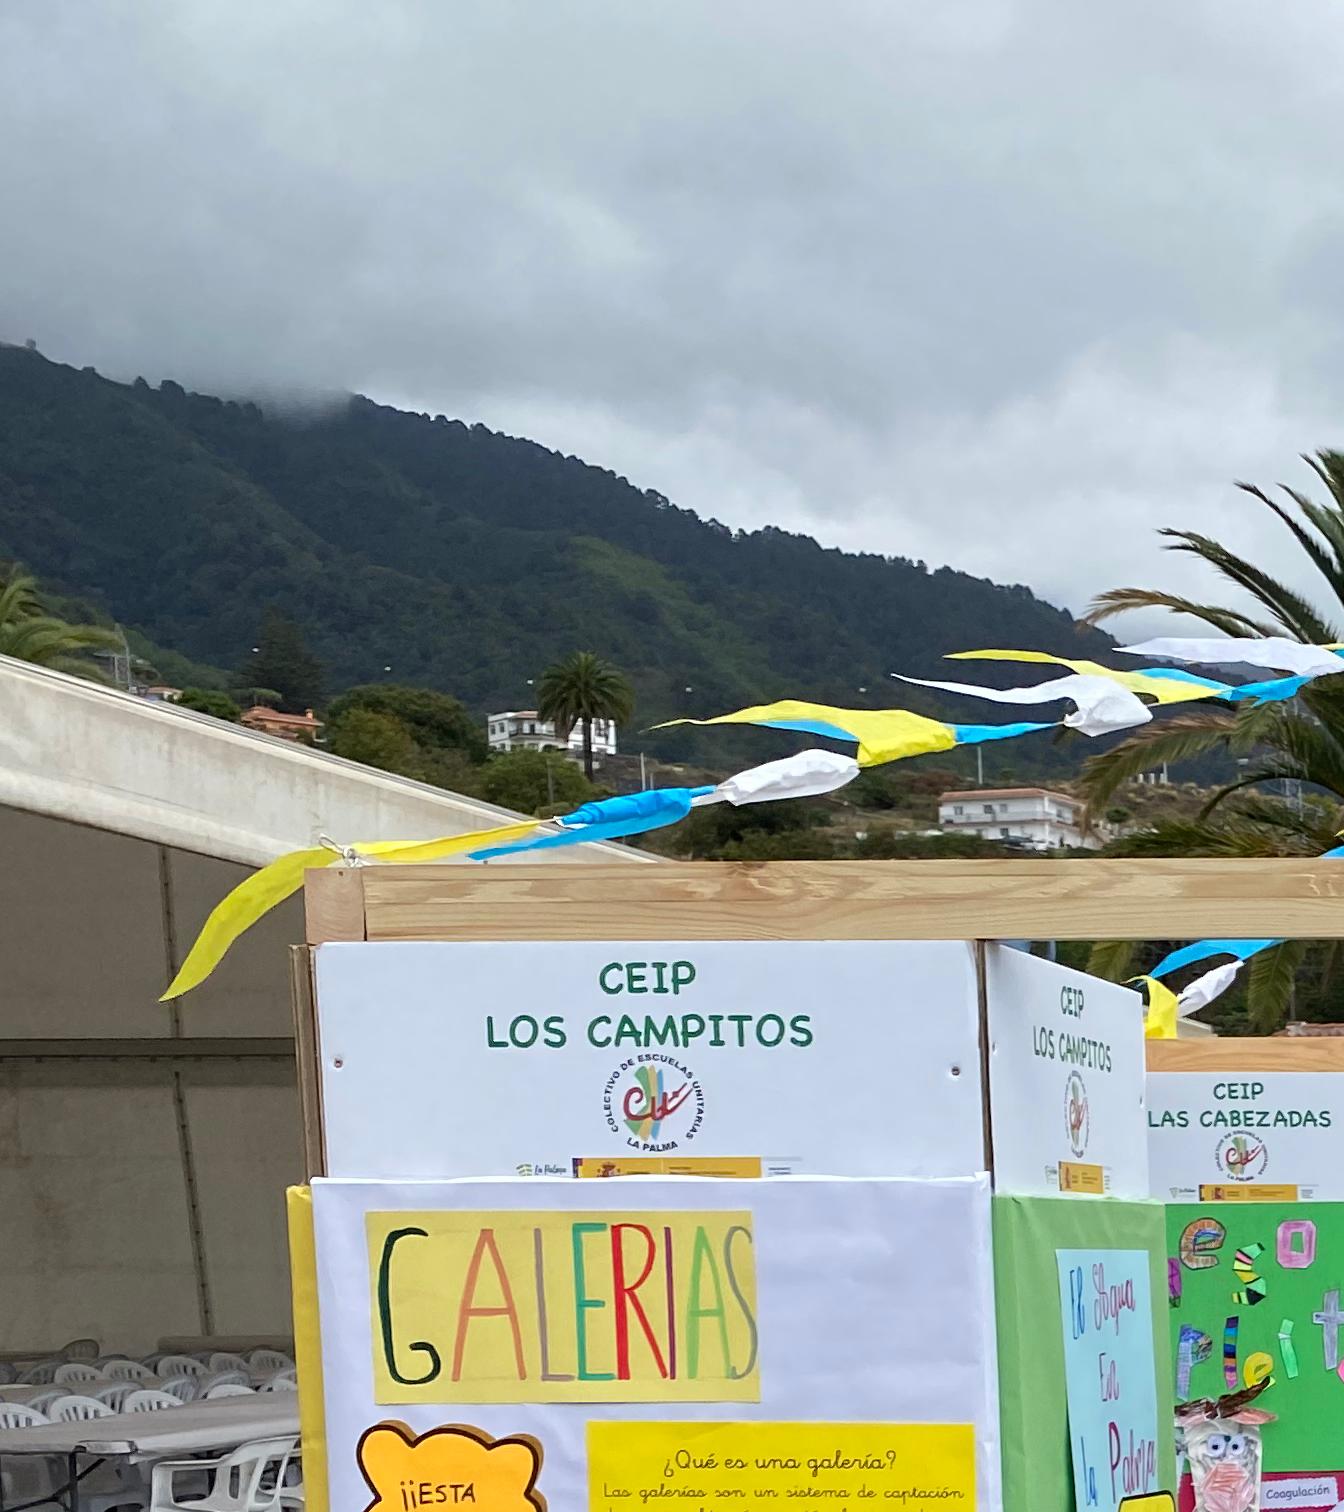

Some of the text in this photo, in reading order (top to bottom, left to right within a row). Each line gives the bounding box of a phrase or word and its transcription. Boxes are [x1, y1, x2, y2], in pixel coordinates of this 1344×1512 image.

[600, 961, 695, 995] CEIP
[1060, 986, 1084, 1019] CEIP
[487, 1014, 812, 1048] LOS CAMPITOS
[1033, 1025, 1112, 1073] LOS CAMPITOS
[604, 1054, 705, 1139] COLECTIVO DE ESCUELAS UNITARIAS
[1214, 1082, 1264, 1100] CEIP
[1149, 1110, 1331, 1128] LAS CABEZADAS
[627, 1137, 678, 1152] LA PALMA
[377, 1221, 758, 1385] GALERIAS
[664, 1449, 897, 1478] ¿Qué es una galería?
[1109, 1421, 1156, 1504] Palma
[401, 1479, 475, 1512] ¡¡ESTA
[1266, 1484, 1330, 1501] Coagulación
